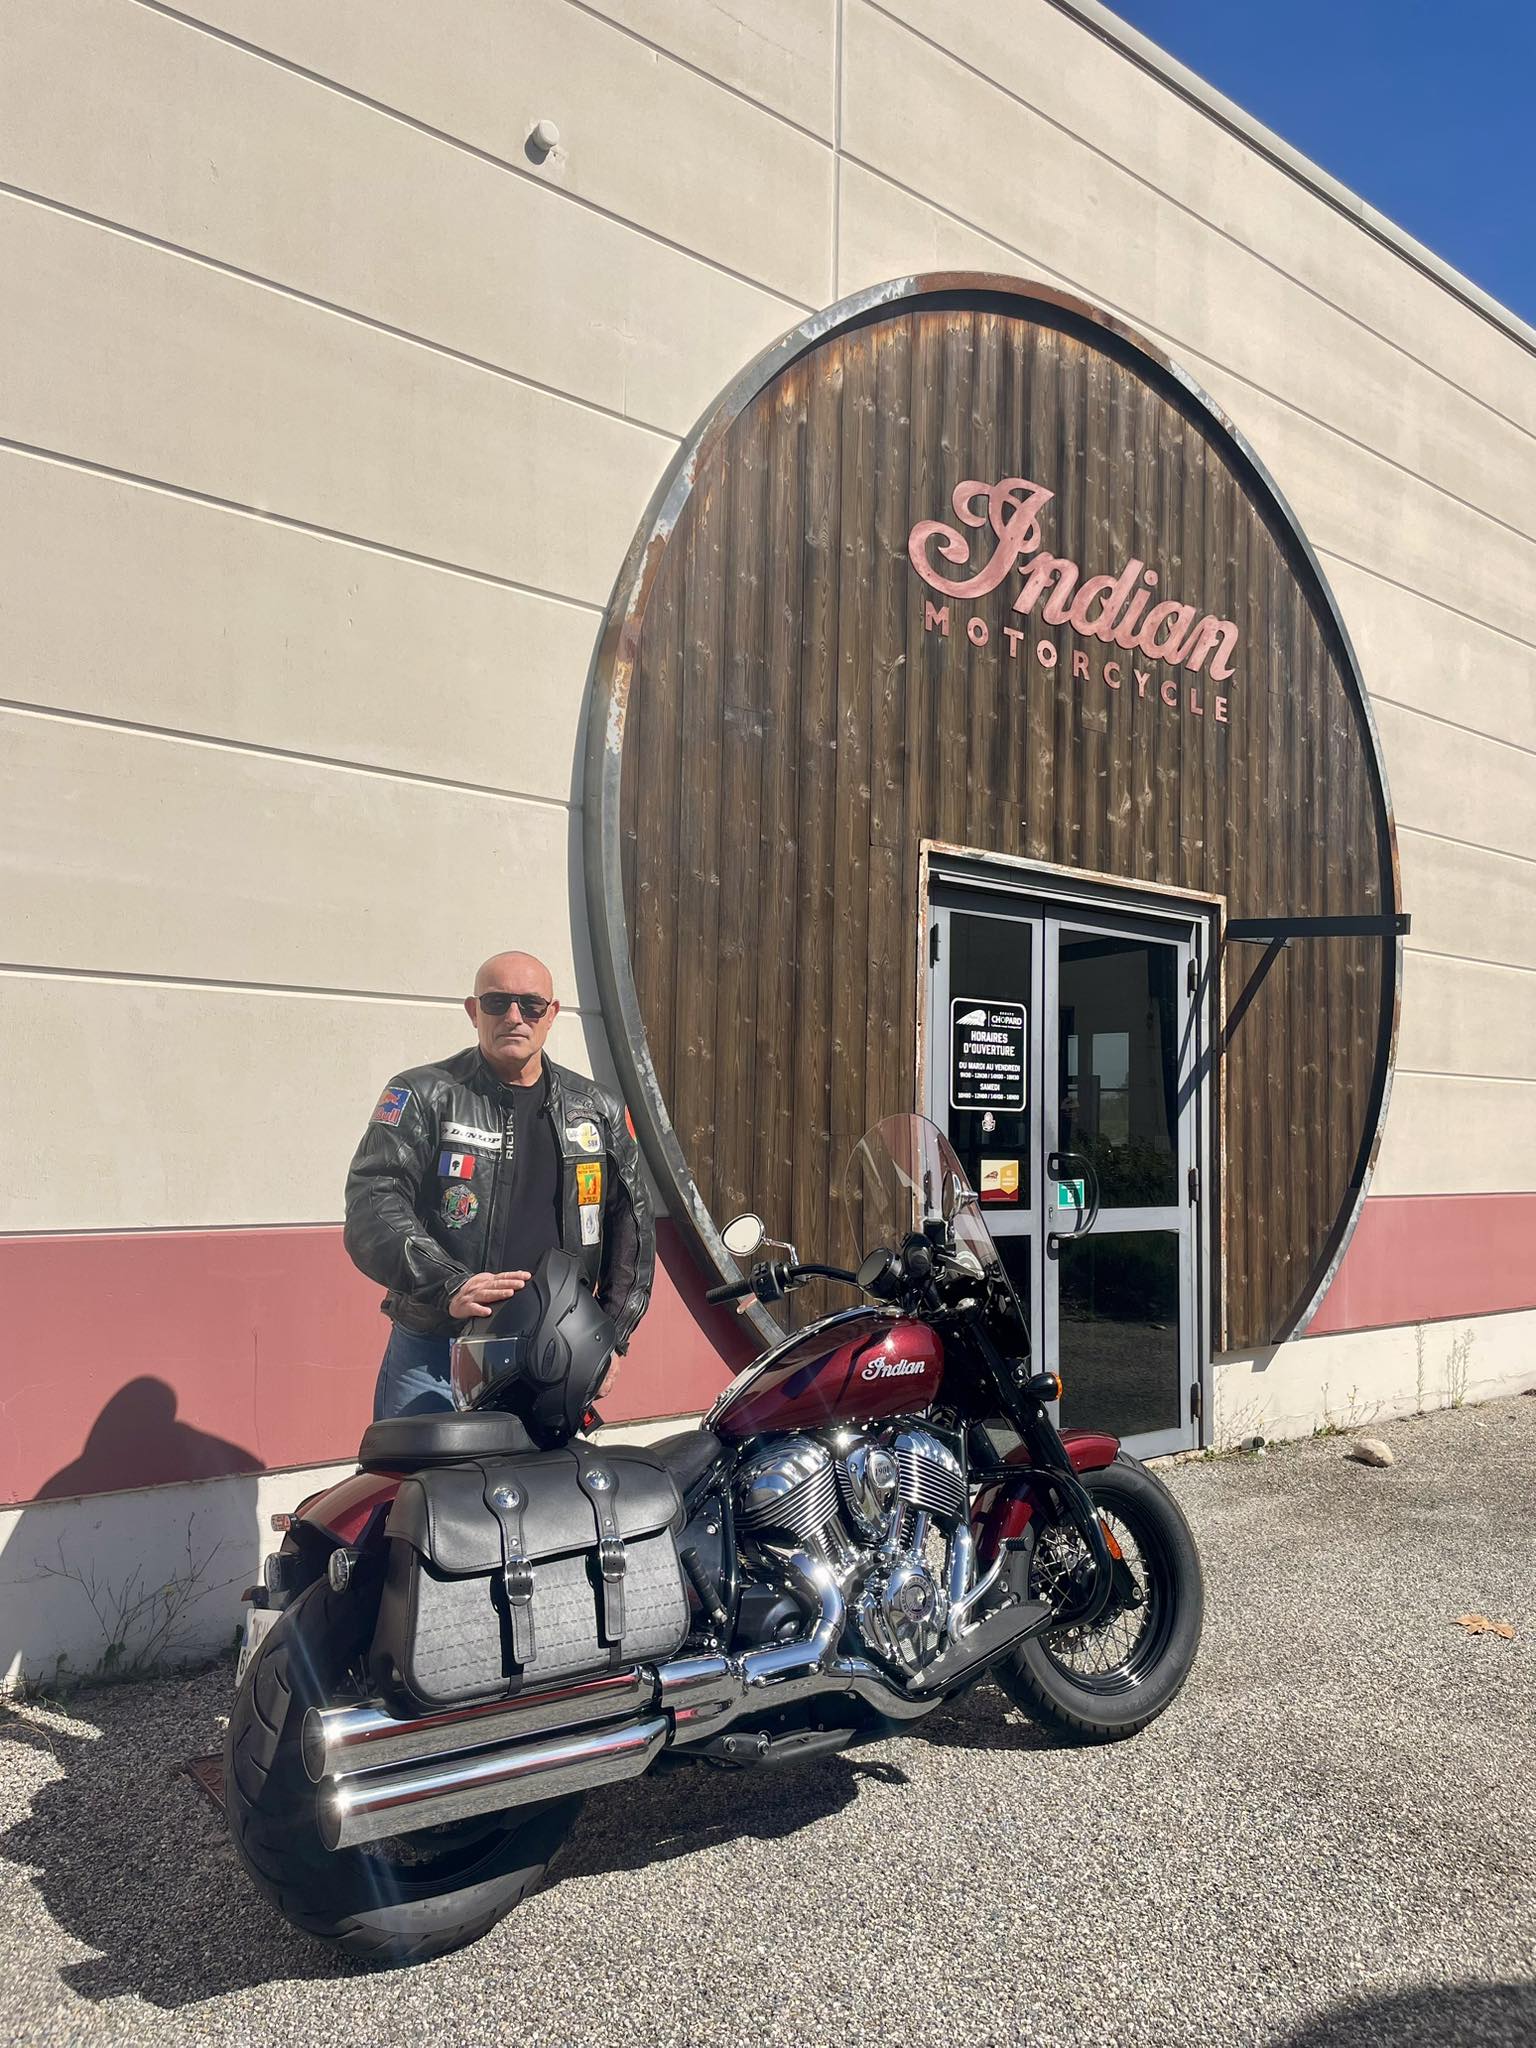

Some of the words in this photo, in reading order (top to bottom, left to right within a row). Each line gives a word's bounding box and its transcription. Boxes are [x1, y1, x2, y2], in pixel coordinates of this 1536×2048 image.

[908, 477, 1239, 681] Indian
[924, 600, 1228, 723] MOTORCYCLE
[991, 1015, 1022, 1025] CHOPARD
[971, 1030, 1008, 1043] HORAIRES
[963, 1043, 1015, 1056] D'OUVERTURE
[968, 1062, 985, 1070] MARDI
[985, 1063, 994, 1071] AU
[995, 1064, 1020, 1072] VENDREDI
[979, 1082, 1000, 1091] SAMEDI
[861, 1356, 926, 1380] Indian
